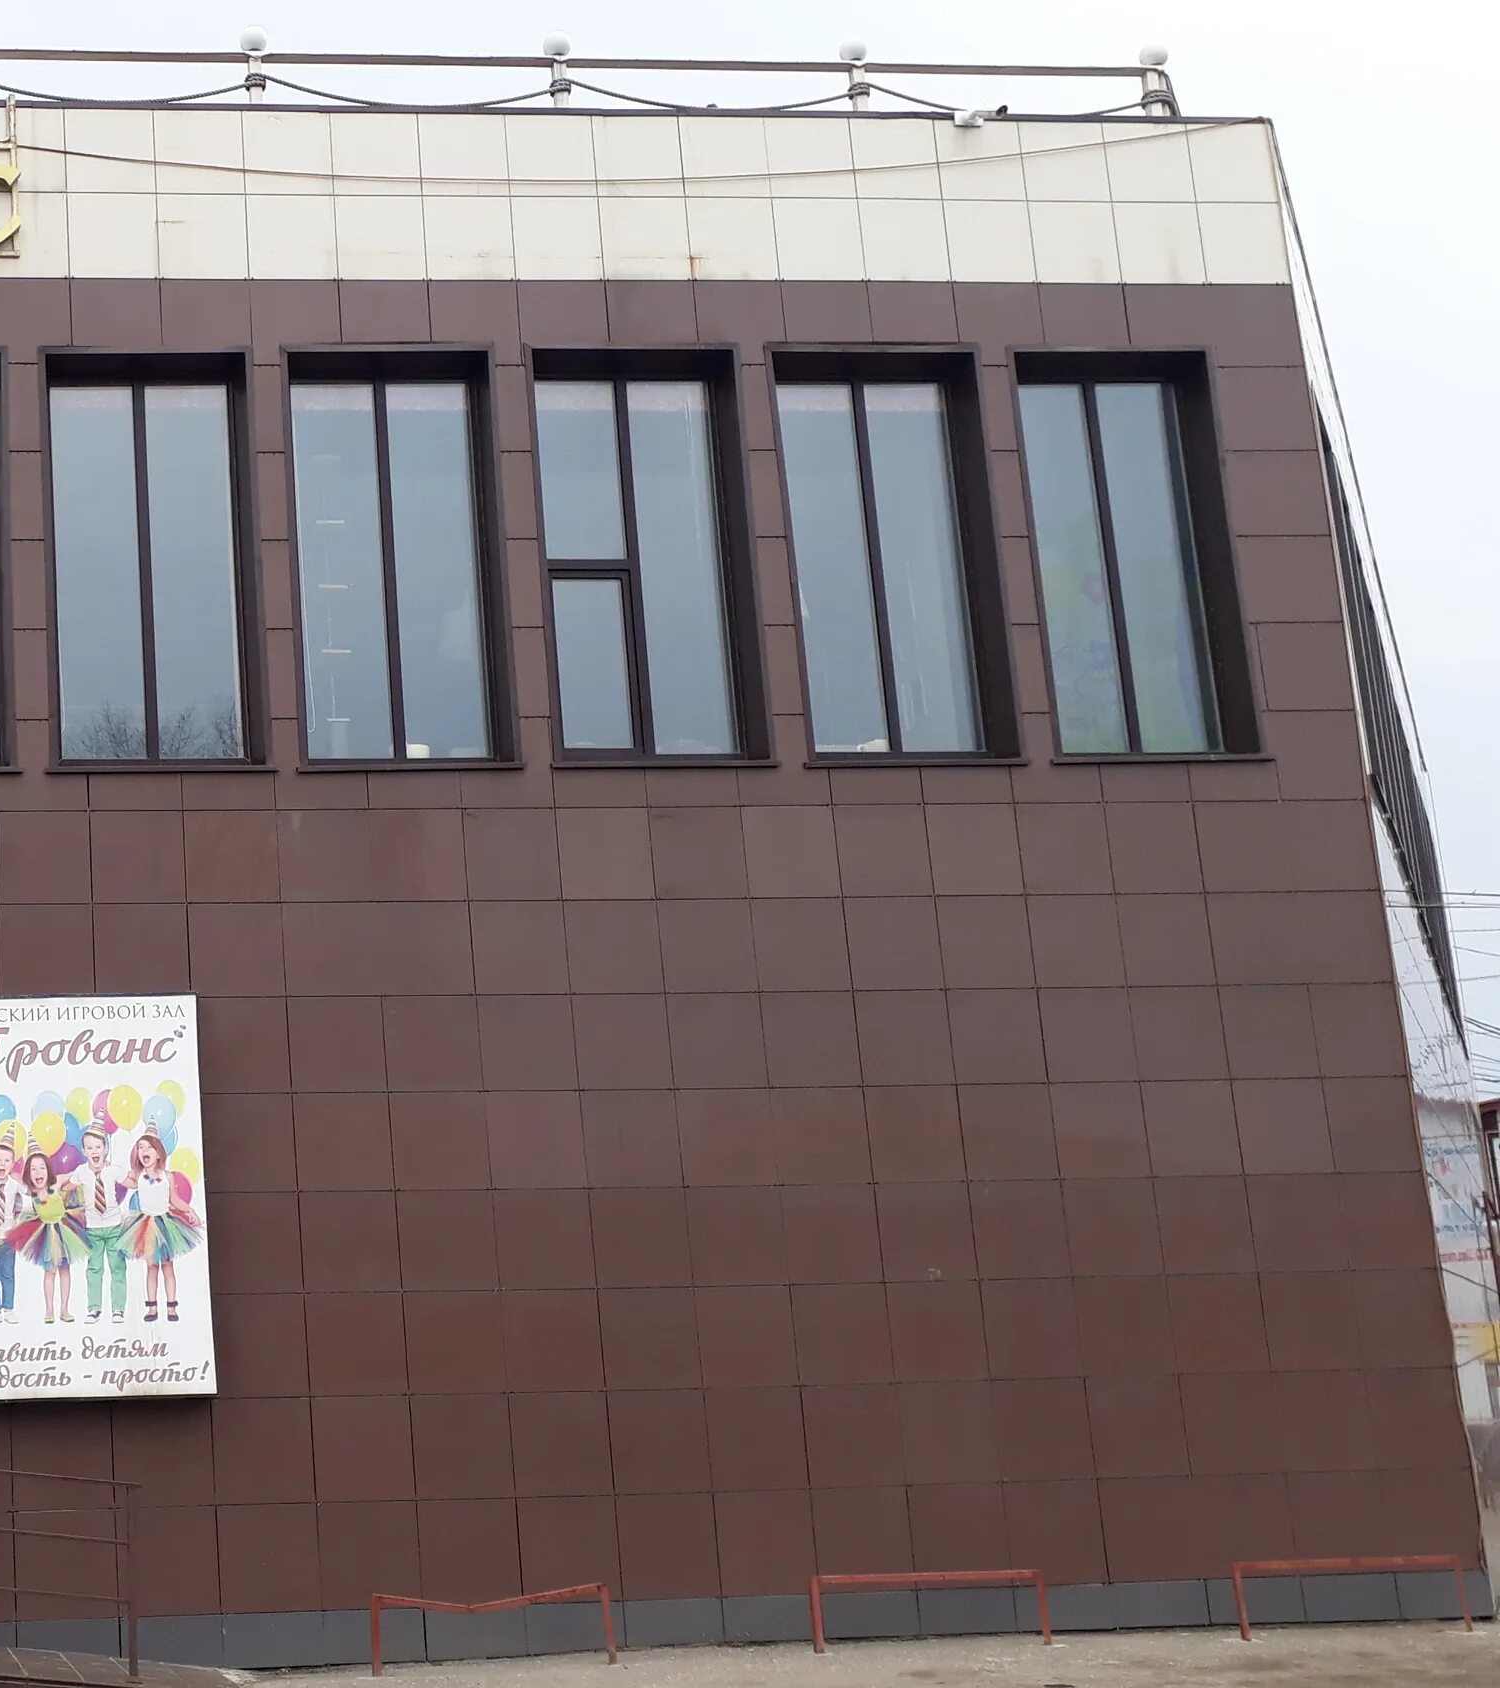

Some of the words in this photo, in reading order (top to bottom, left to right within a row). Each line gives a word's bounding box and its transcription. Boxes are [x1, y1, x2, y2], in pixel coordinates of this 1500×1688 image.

[57, 1002, 147, 1022] ИГРОВОЙ
[152, 1004, 186, 1019] ЗАЛ
[81, 1336, 170, 1360] детям
[100, 1360, 210, 1392] просто!
